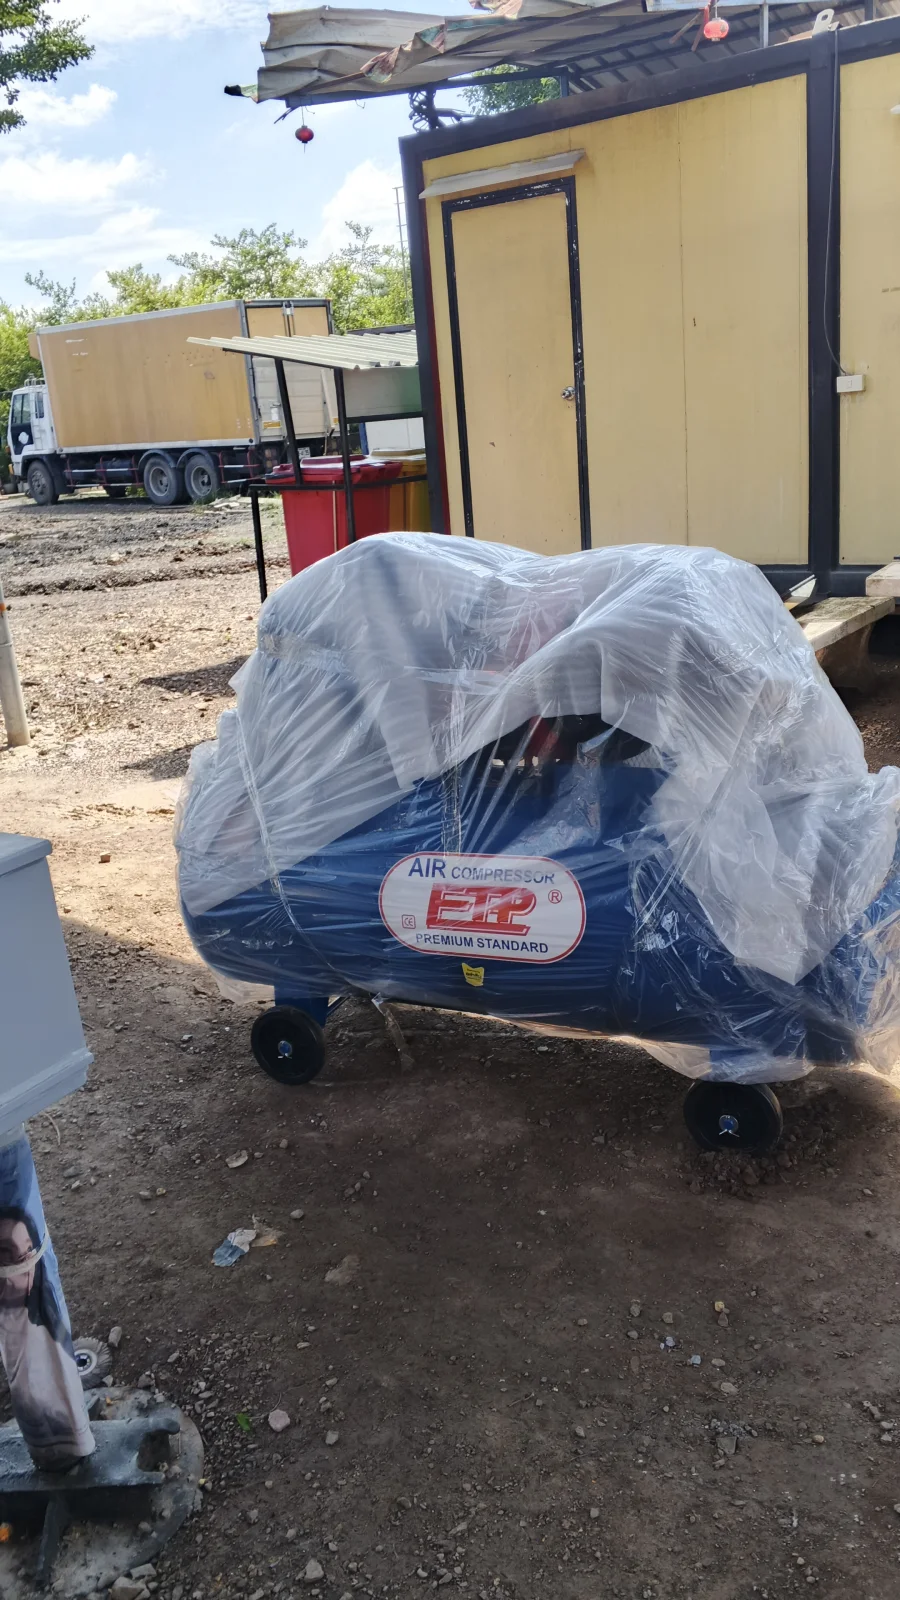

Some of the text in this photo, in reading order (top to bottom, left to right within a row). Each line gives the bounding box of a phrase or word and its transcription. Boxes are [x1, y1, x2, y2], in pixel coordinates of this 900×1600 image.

[408, 857, 555, 885] AIR COMPRESSOR
[416, 933, 549, 954] PREMIUM STANDARD
